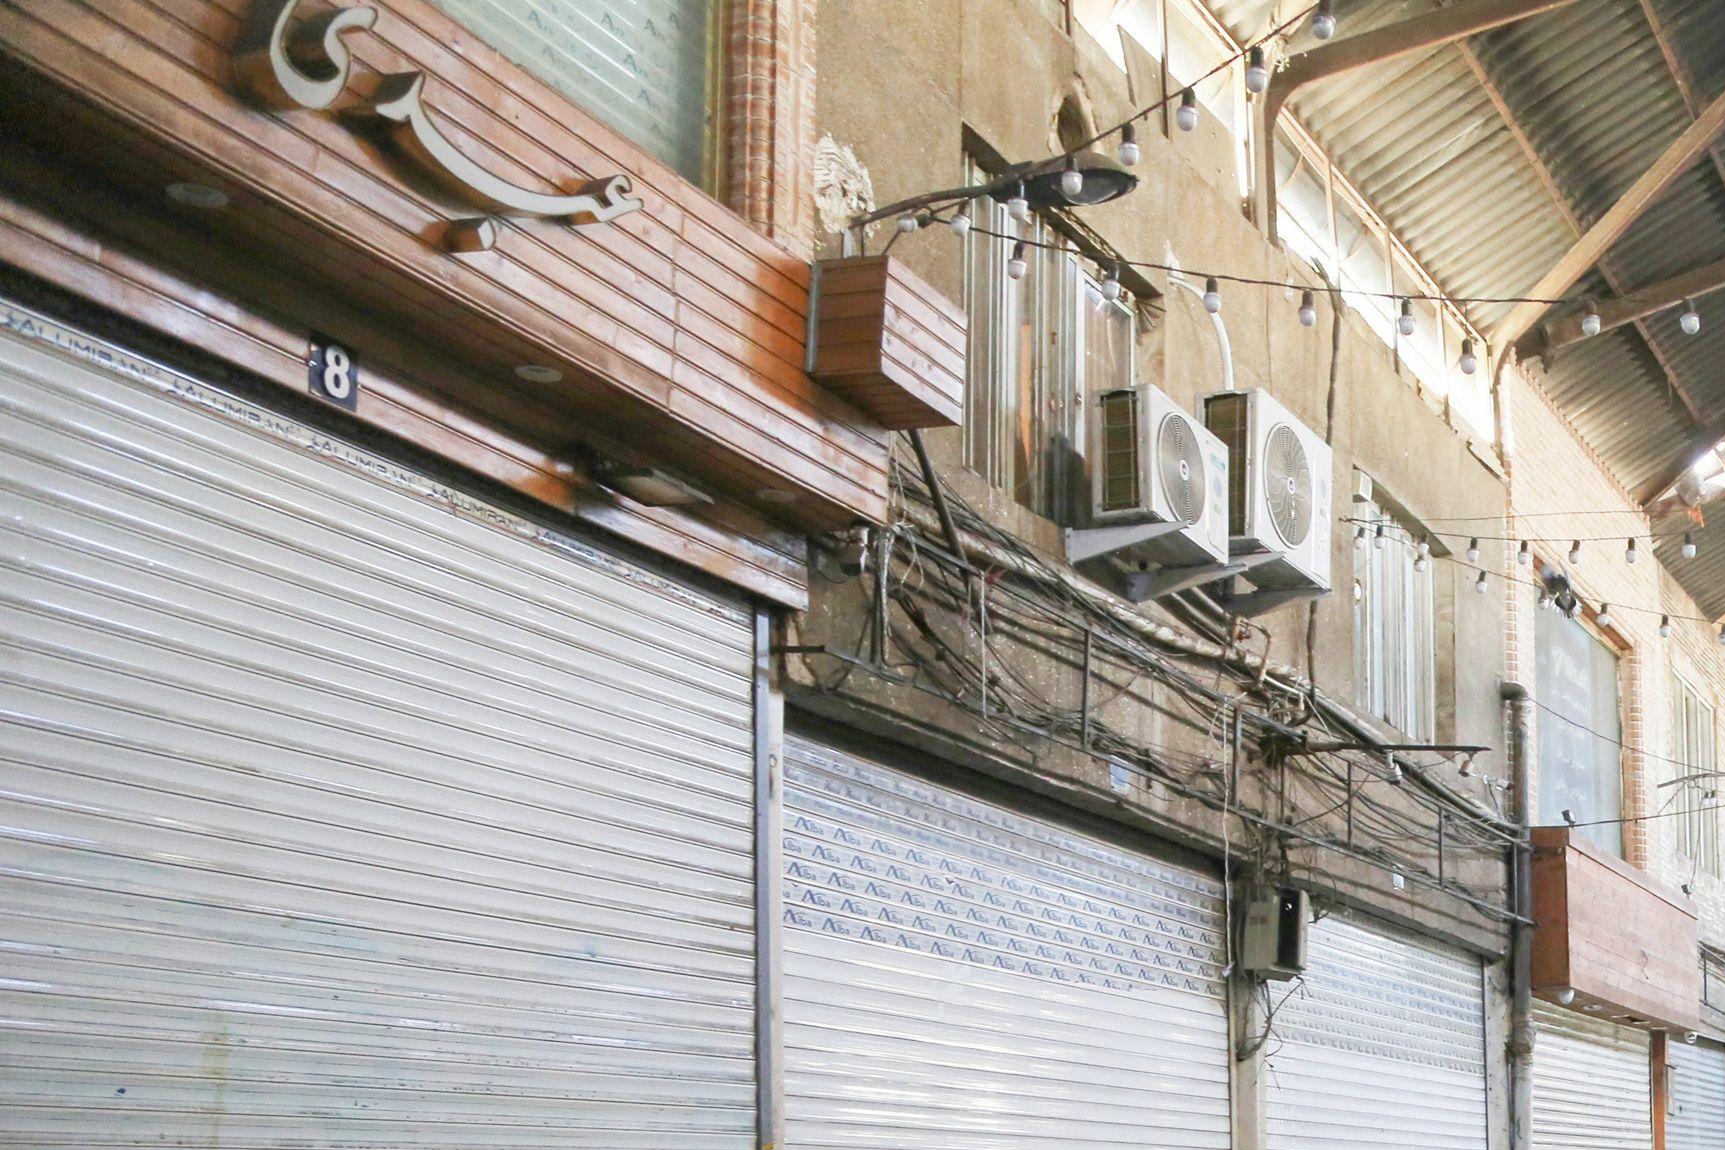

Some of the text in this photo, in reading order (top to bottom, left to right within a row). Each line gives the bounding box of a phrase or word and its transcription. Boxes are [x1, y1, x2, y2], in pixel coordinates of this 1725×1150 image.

[324, 345, 350, 398] 8
[795, 817, 823, 835] Alba
[834, 828, 860, 845] Alba
[871, 839, 896, 855] Alba
[783, 838, 801, 853] lba
[812, 845, 840, 862] Alba
[850, 855, 876, 872] Alba
[886, 865, 911, 882] Alba
[787, 862, 816, 880] Alba
[827, 872, 855, 890] Alba
[865, 882, 891, 899] Alba
[802, 890, 830, 907] Alba
[841, 899, 868, 916] Alba
[879, 908, 904, 924] Alba
[783, 909, 812, 926] Alba
[822, 917, 850, 935] Alba
[860, 926, 887, 943] Alba
[895, 934, 920, 949] Alba
